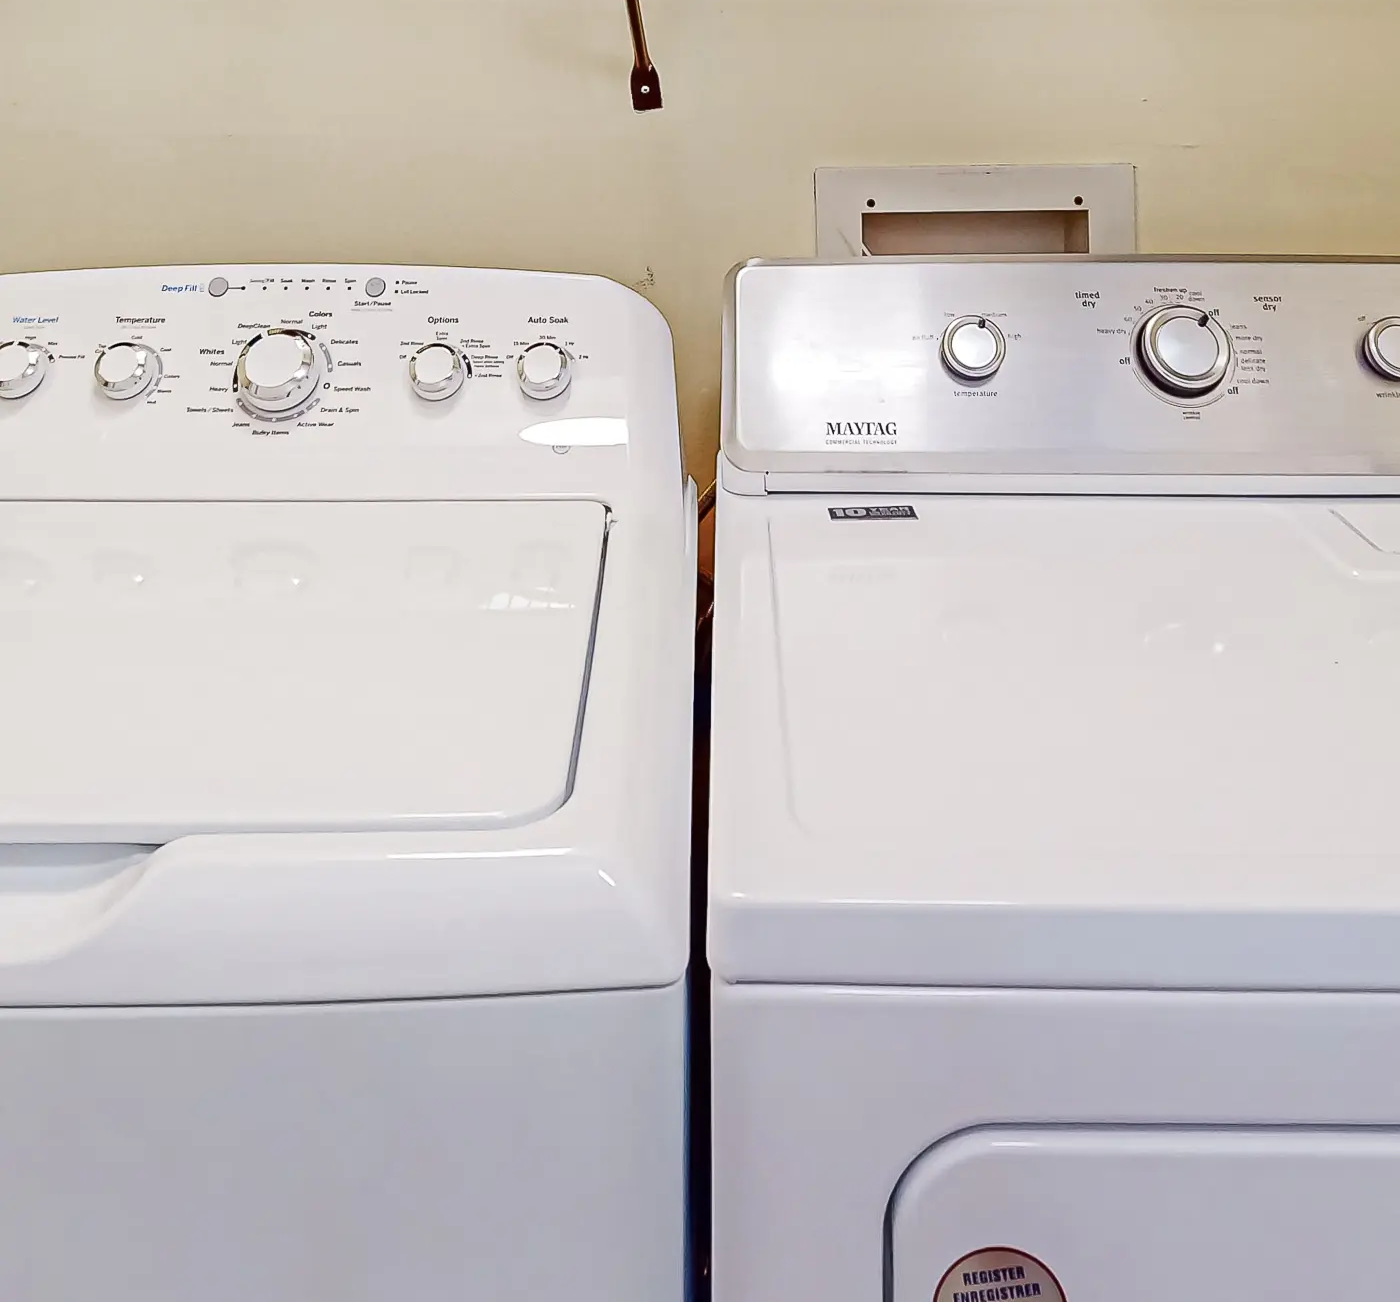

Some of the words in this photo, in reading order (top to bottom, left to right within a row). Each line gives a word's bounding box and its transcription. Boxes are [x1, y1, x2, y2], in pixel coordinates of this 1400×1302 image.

[161, 284, 184, 293] Deep
[184, 284, 198, 292] Fill
[1074, 291, 1101, 299] timed
[1082, 300, 1096, 308] dry
[1262, 302, 1277, 312] dry
[308, 310, 333, 318] Colors
[1208, 309, 1220, 317] off
[37, 316, 59, 324] Level
[115, 316, 166, 324] Temperature
[427, 316, 459, 325] Options
[528, 316, 547, 324] Auto
[549, 316, 569, 324] Soak
[311, 323, 328, 331] Light
[1119, 357, 1131, 365] off
[1227, 386, 1239, 395] off
[825, 422, 898, 436] MAYTAG
[832, 508, 867, 517] 10
[962, 1265, 1026, 1286] REGISTER
[952, 1282, 1042, 1302] ENREGISTRER
